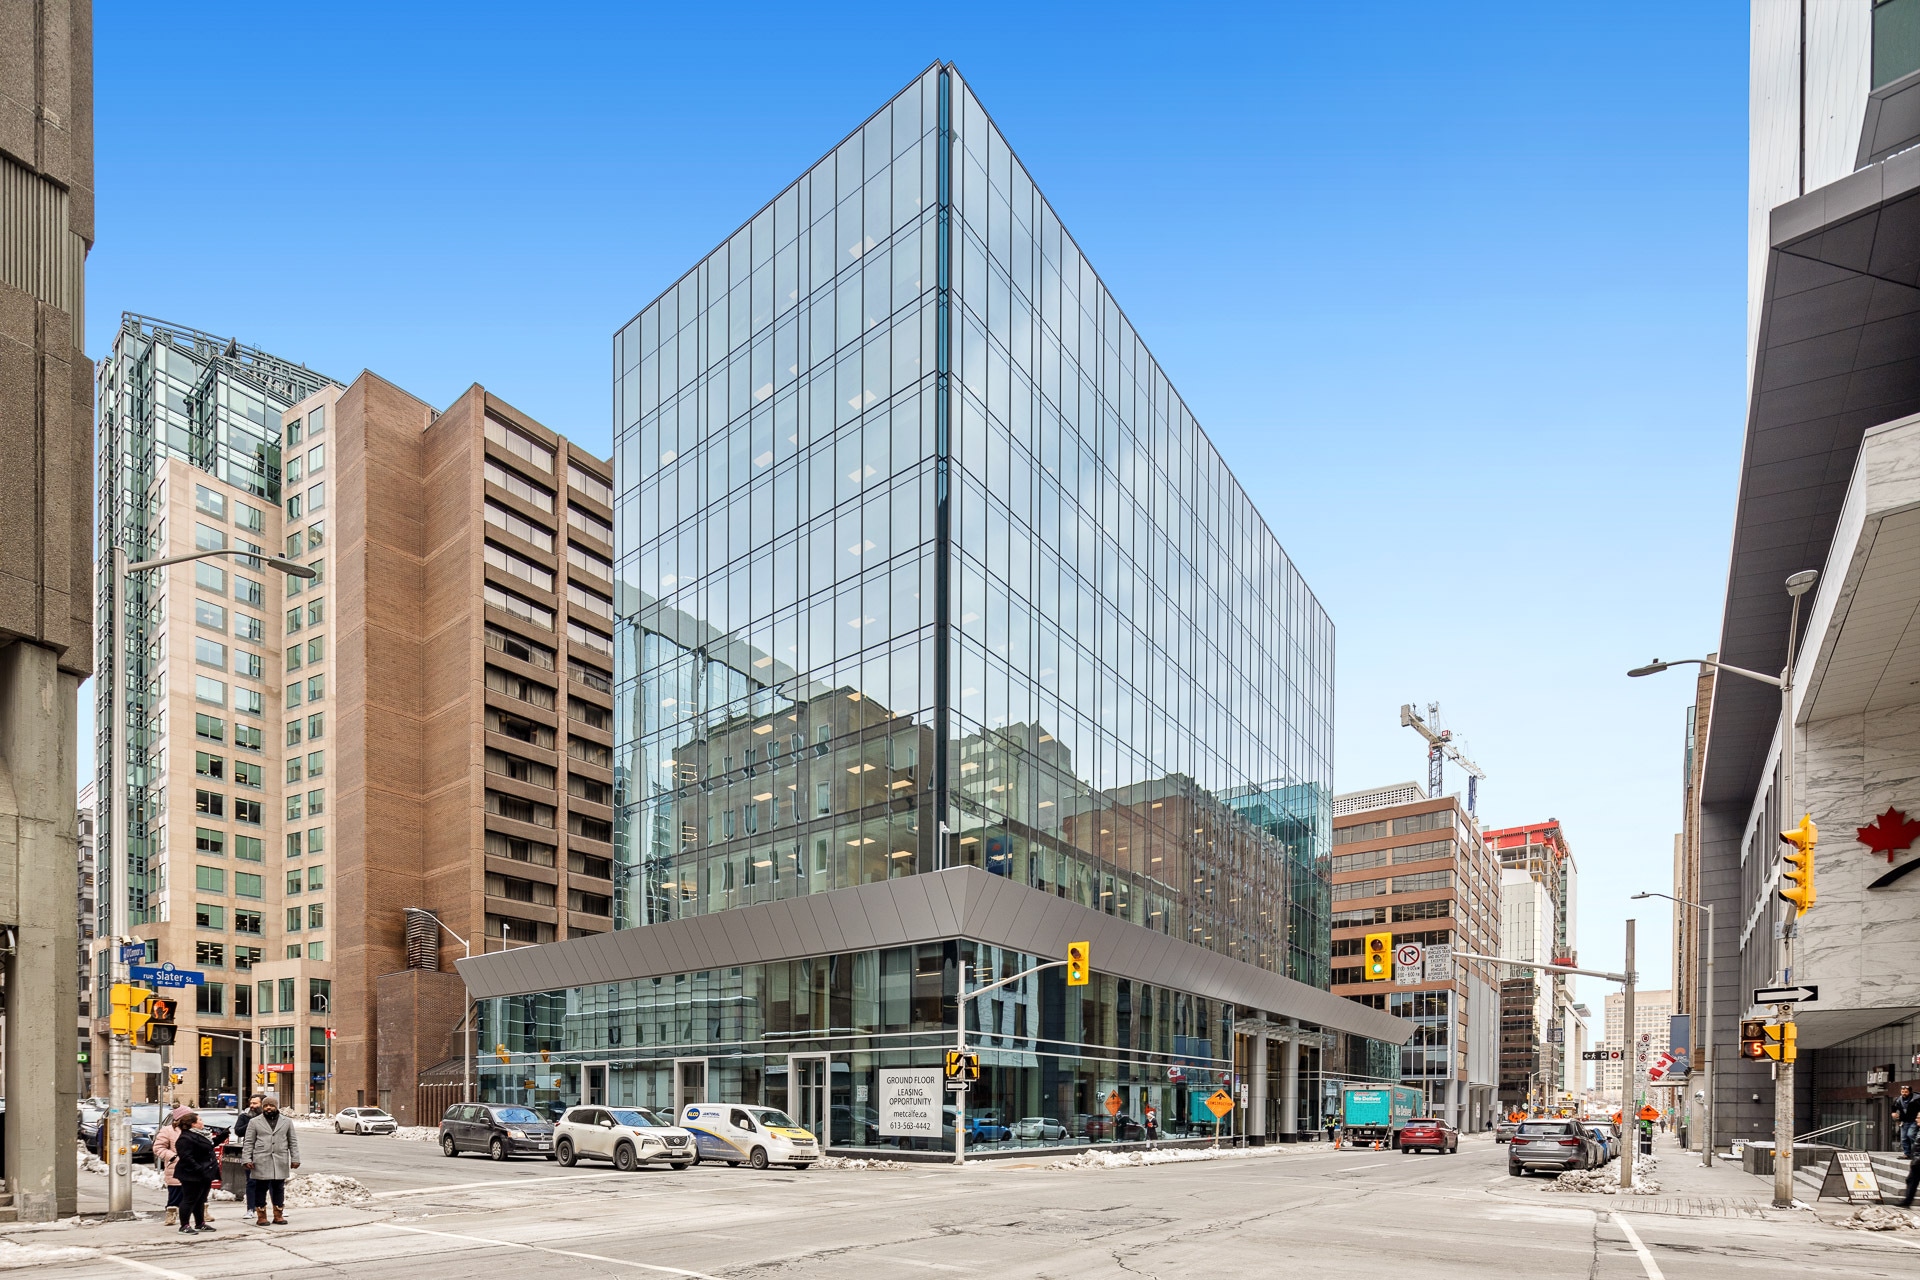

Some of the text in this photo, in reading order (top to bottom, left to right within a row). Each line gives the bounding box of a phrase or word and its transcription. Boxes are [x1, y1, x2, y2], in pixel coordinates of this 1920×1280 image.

[156, 971, 183, 981] Slater
[1753, 1043, 1762, 1055] 5
[889, 1097, 932, 1106] OPPORTUNITY
[894, 1110, 927, 1118] metcalfe.ca
[890, 1122, 930, 1130] 613-563-4442
